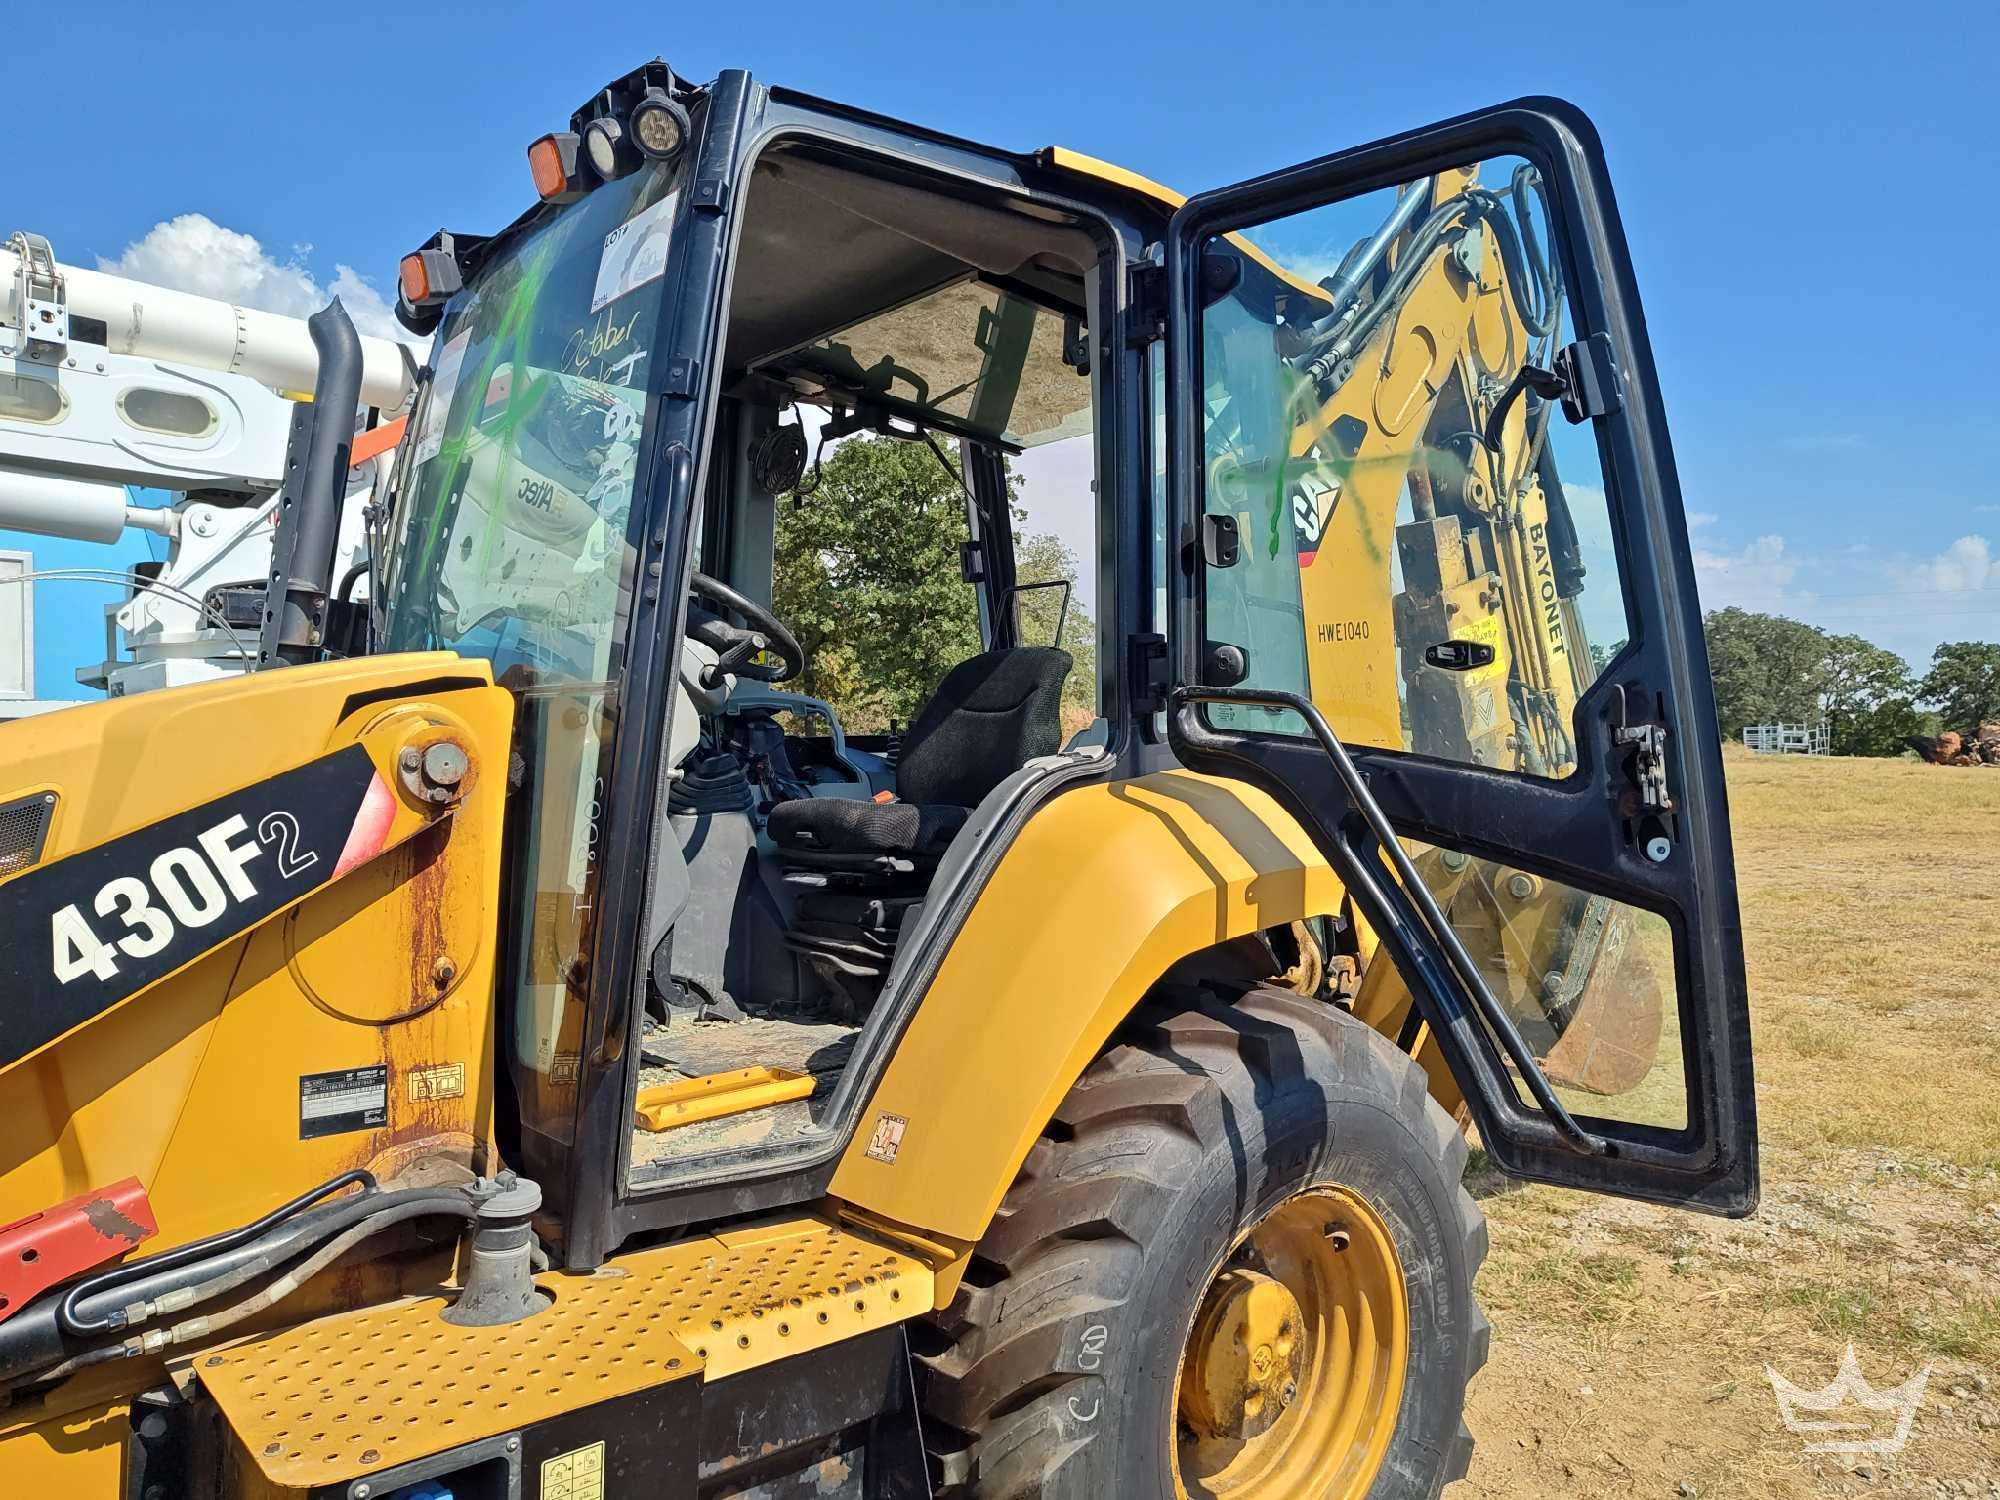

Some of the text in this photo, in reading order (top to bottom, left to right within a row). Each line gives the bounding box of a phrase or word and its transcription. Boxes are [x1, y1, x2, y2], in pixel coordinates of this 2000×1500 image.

[560, 306, 640, 373] October
[1317, 621, 1371, 643] HWE1040
[1529, 521, 1566, 655] BAYONET
[51, 811, 319, 985] 430F2
